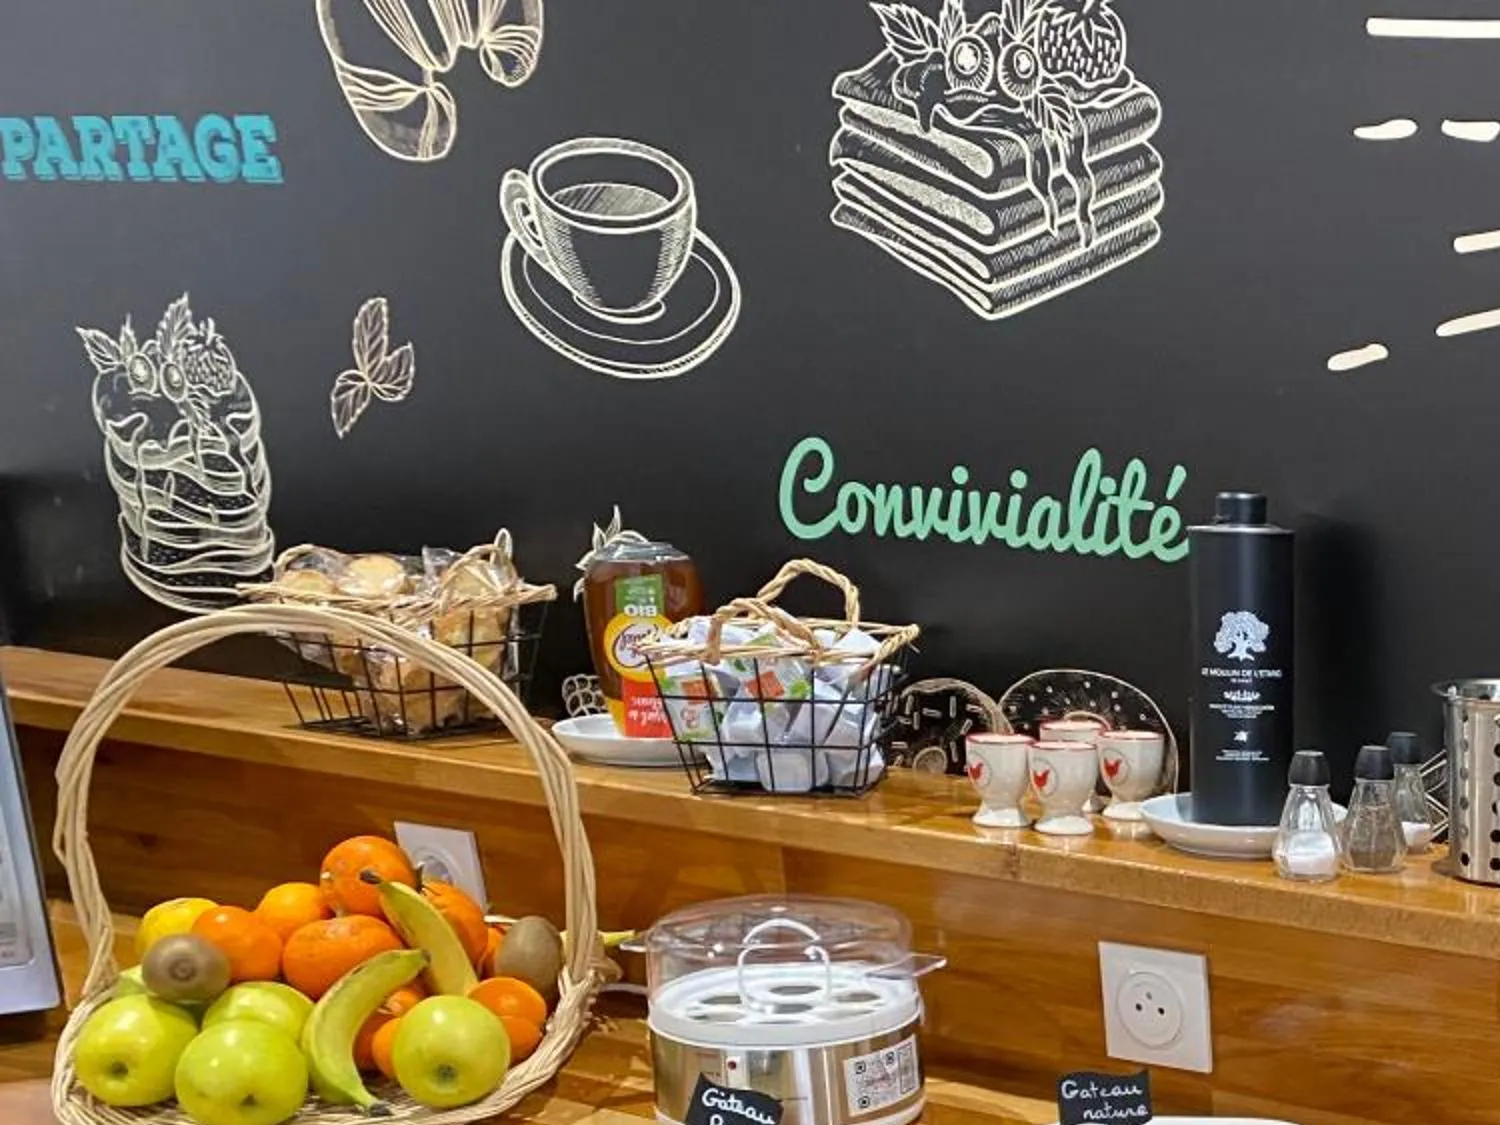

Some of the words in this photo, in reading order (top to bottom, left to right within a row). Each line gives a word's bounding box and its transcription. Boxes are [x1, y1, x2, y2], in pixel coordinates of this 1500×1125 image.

[0, 114, 284, 183] PARTAGE
[779, 436, 1190, 563] Convivialité
[1083, 1101, 1148, 1120] nature
